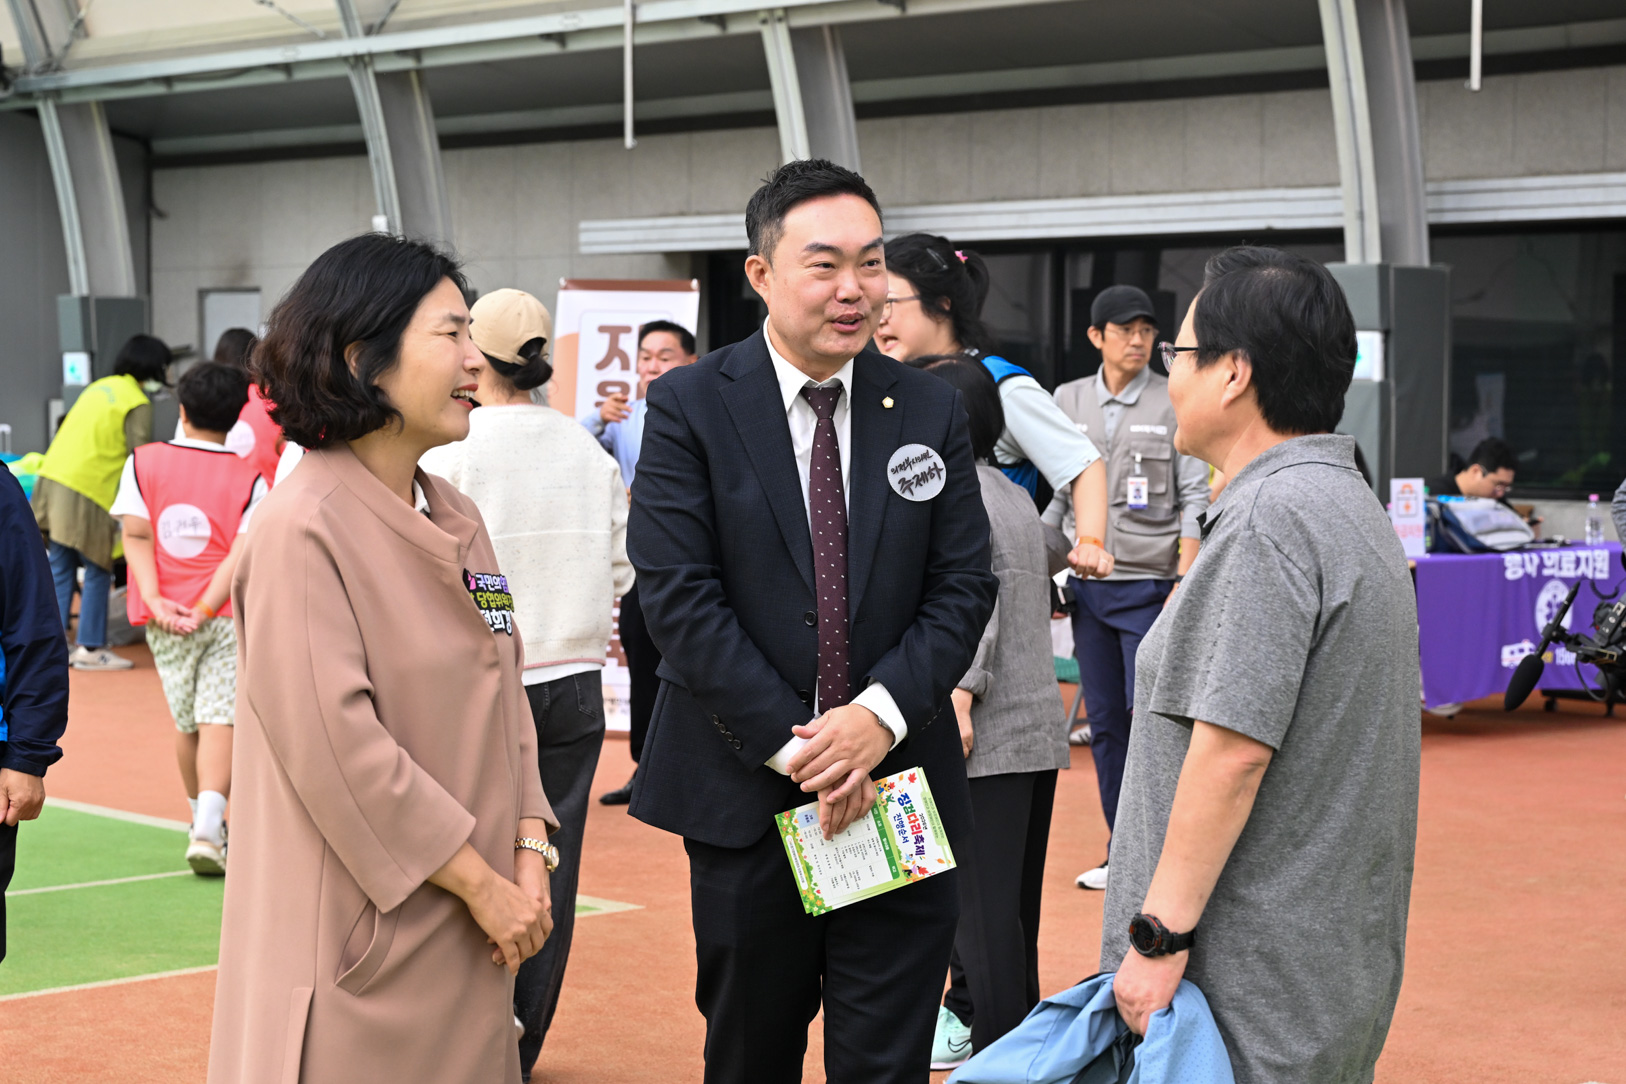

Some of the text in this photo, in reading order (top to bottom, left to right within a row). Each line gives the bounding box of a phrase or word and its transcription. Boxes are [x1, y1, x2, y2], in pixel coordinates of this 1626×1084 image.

[1503, 549, 1609, 580] 행사 의료지원
[475, 573, 509, 593] 국민의힘
[893, 813, 909, 844] 진행순서
[897, 792, 926, 856] 징검다리축제
